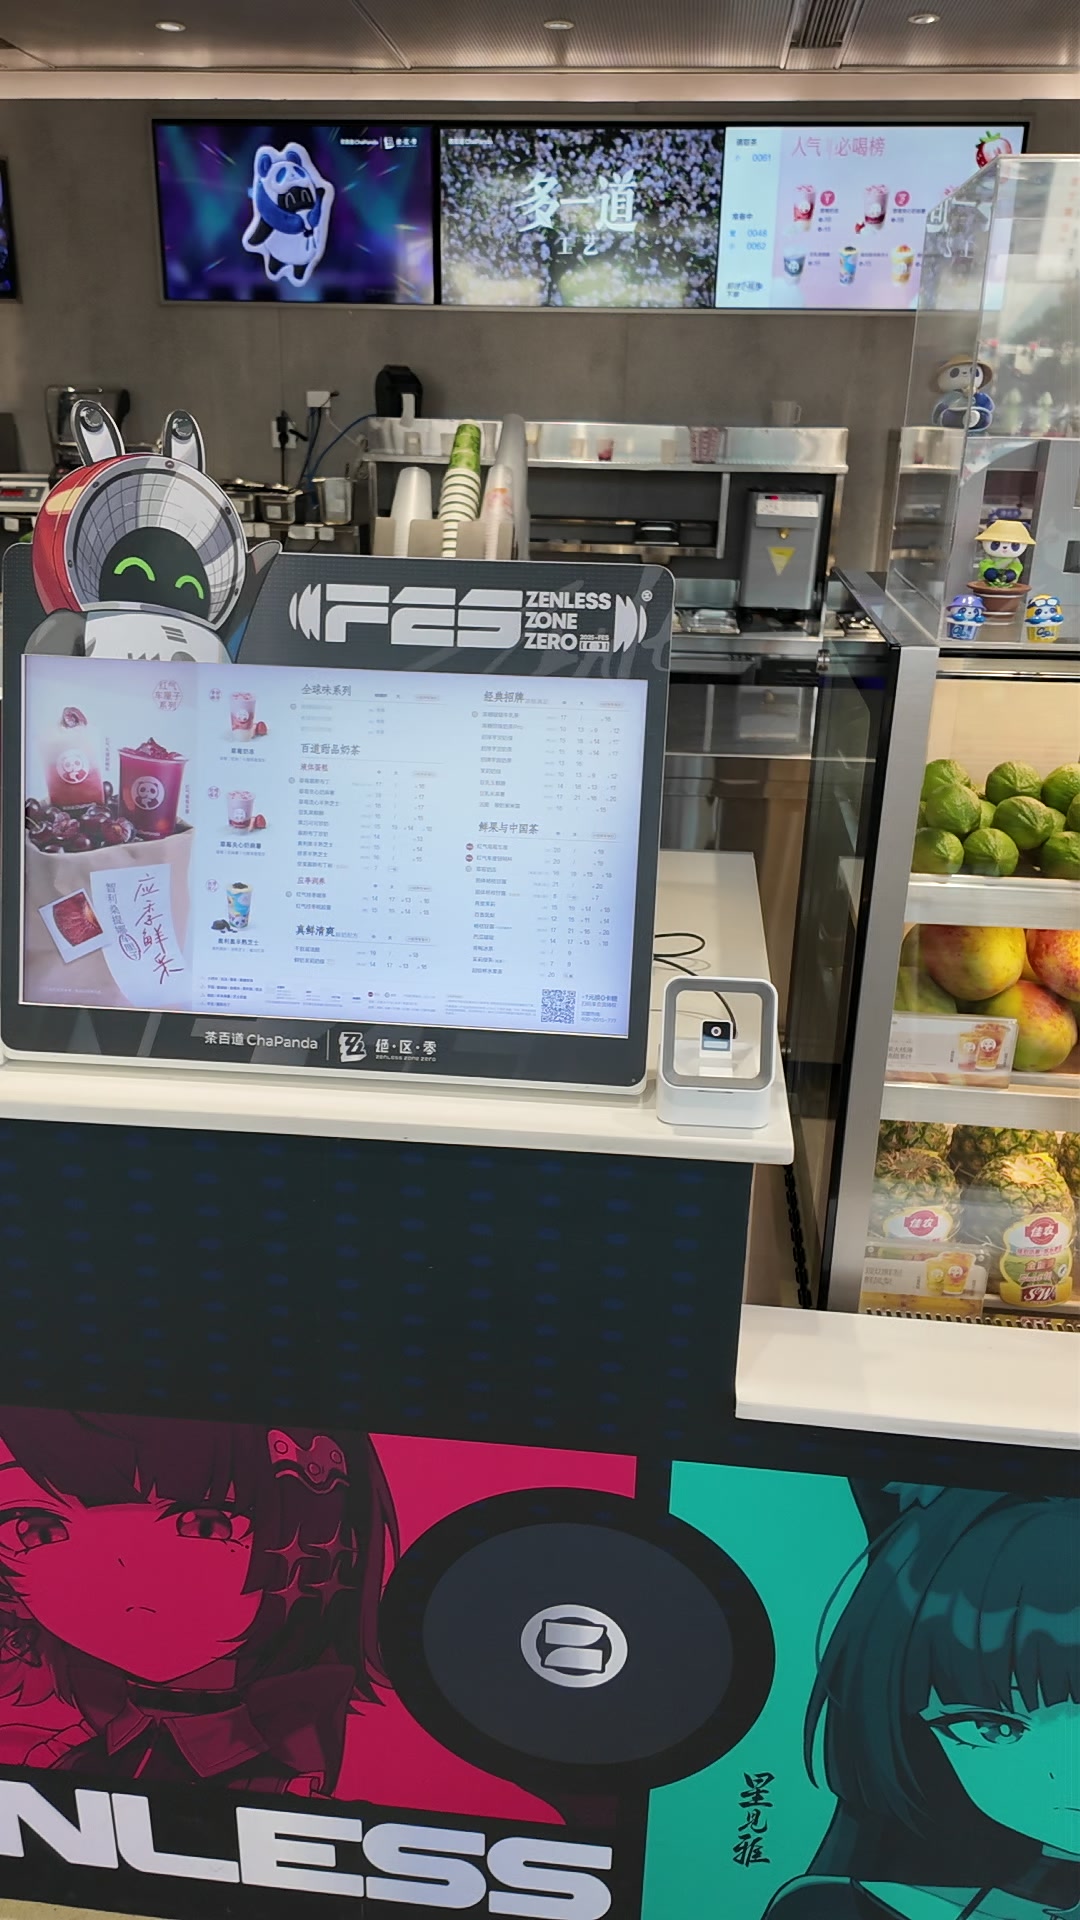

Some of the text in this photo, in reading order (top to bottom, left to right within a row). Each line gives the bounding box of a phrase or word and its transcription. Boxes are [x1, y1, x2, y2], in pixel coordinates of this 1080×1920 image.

[792, 136, 885, 157] 人气 必喝榜
[512, 168, 638, 232] 多一道
[558, 234, 600, 256] 工艺
[526, 590, 612, 610] ZENLESS
[325, 583, 523, 648] FES
[525, 611, 578, 630] ZONE
[524, 632, 577, 650] ZERO
[301, 683, 351, 697] 全球味系列
[484, 691, 524, 703] 经典招牌
[301, 743, 361, 756] 百道甜品奶茶
[478, 821, 539, 834] 鲜果与中国茶
[296, 924, 335, 936] 真鲜清爽
[205, 1031, 319, 1050] 茶百道 ChaPanda
[910, 1217, 934, 1229] 佳农
[1031, 1225, 1056, 1238] 佳农
